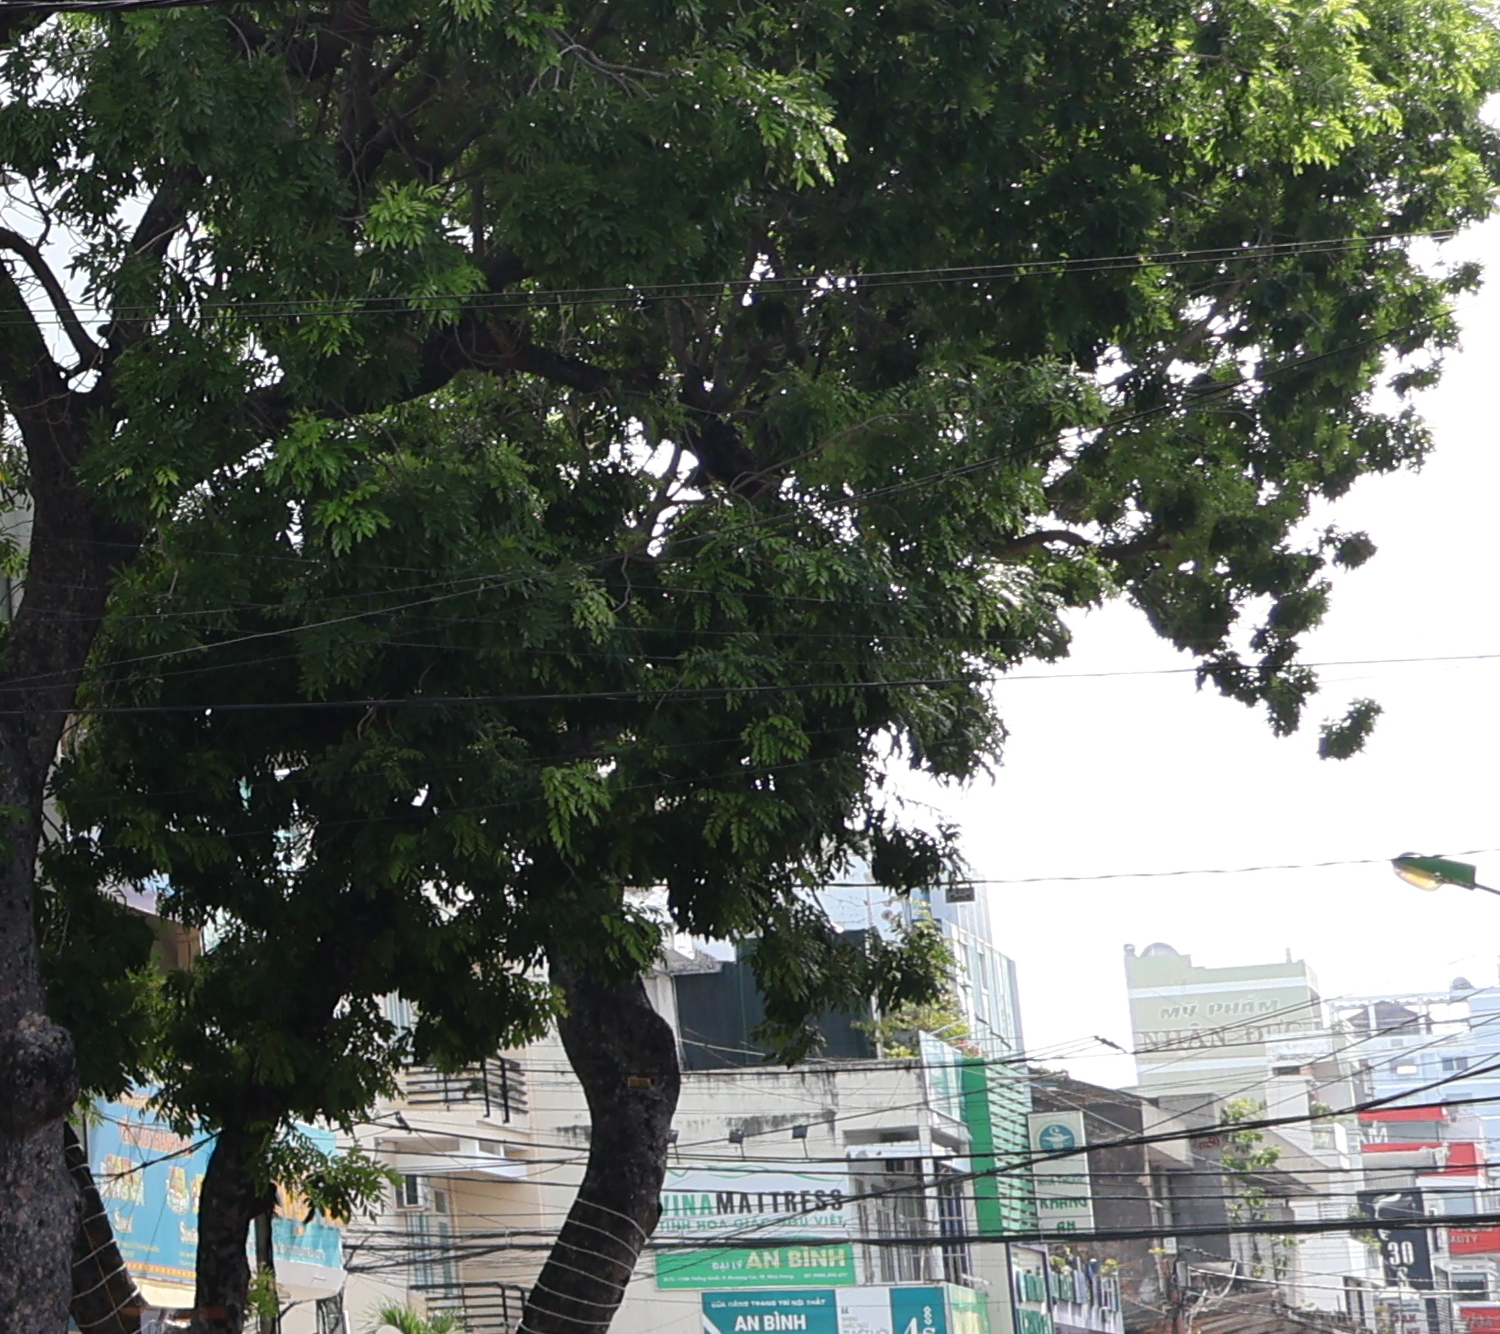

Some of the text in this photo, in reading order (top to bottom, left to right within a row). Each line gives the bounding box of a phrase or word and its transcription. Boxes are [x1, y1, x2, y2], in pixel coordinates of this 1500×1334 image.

[746, 1250, 780, 1269] AN
[788, 1245, 846, 1268] BÌNH
[734, 1311, 807, 1331] AN BÌNH
